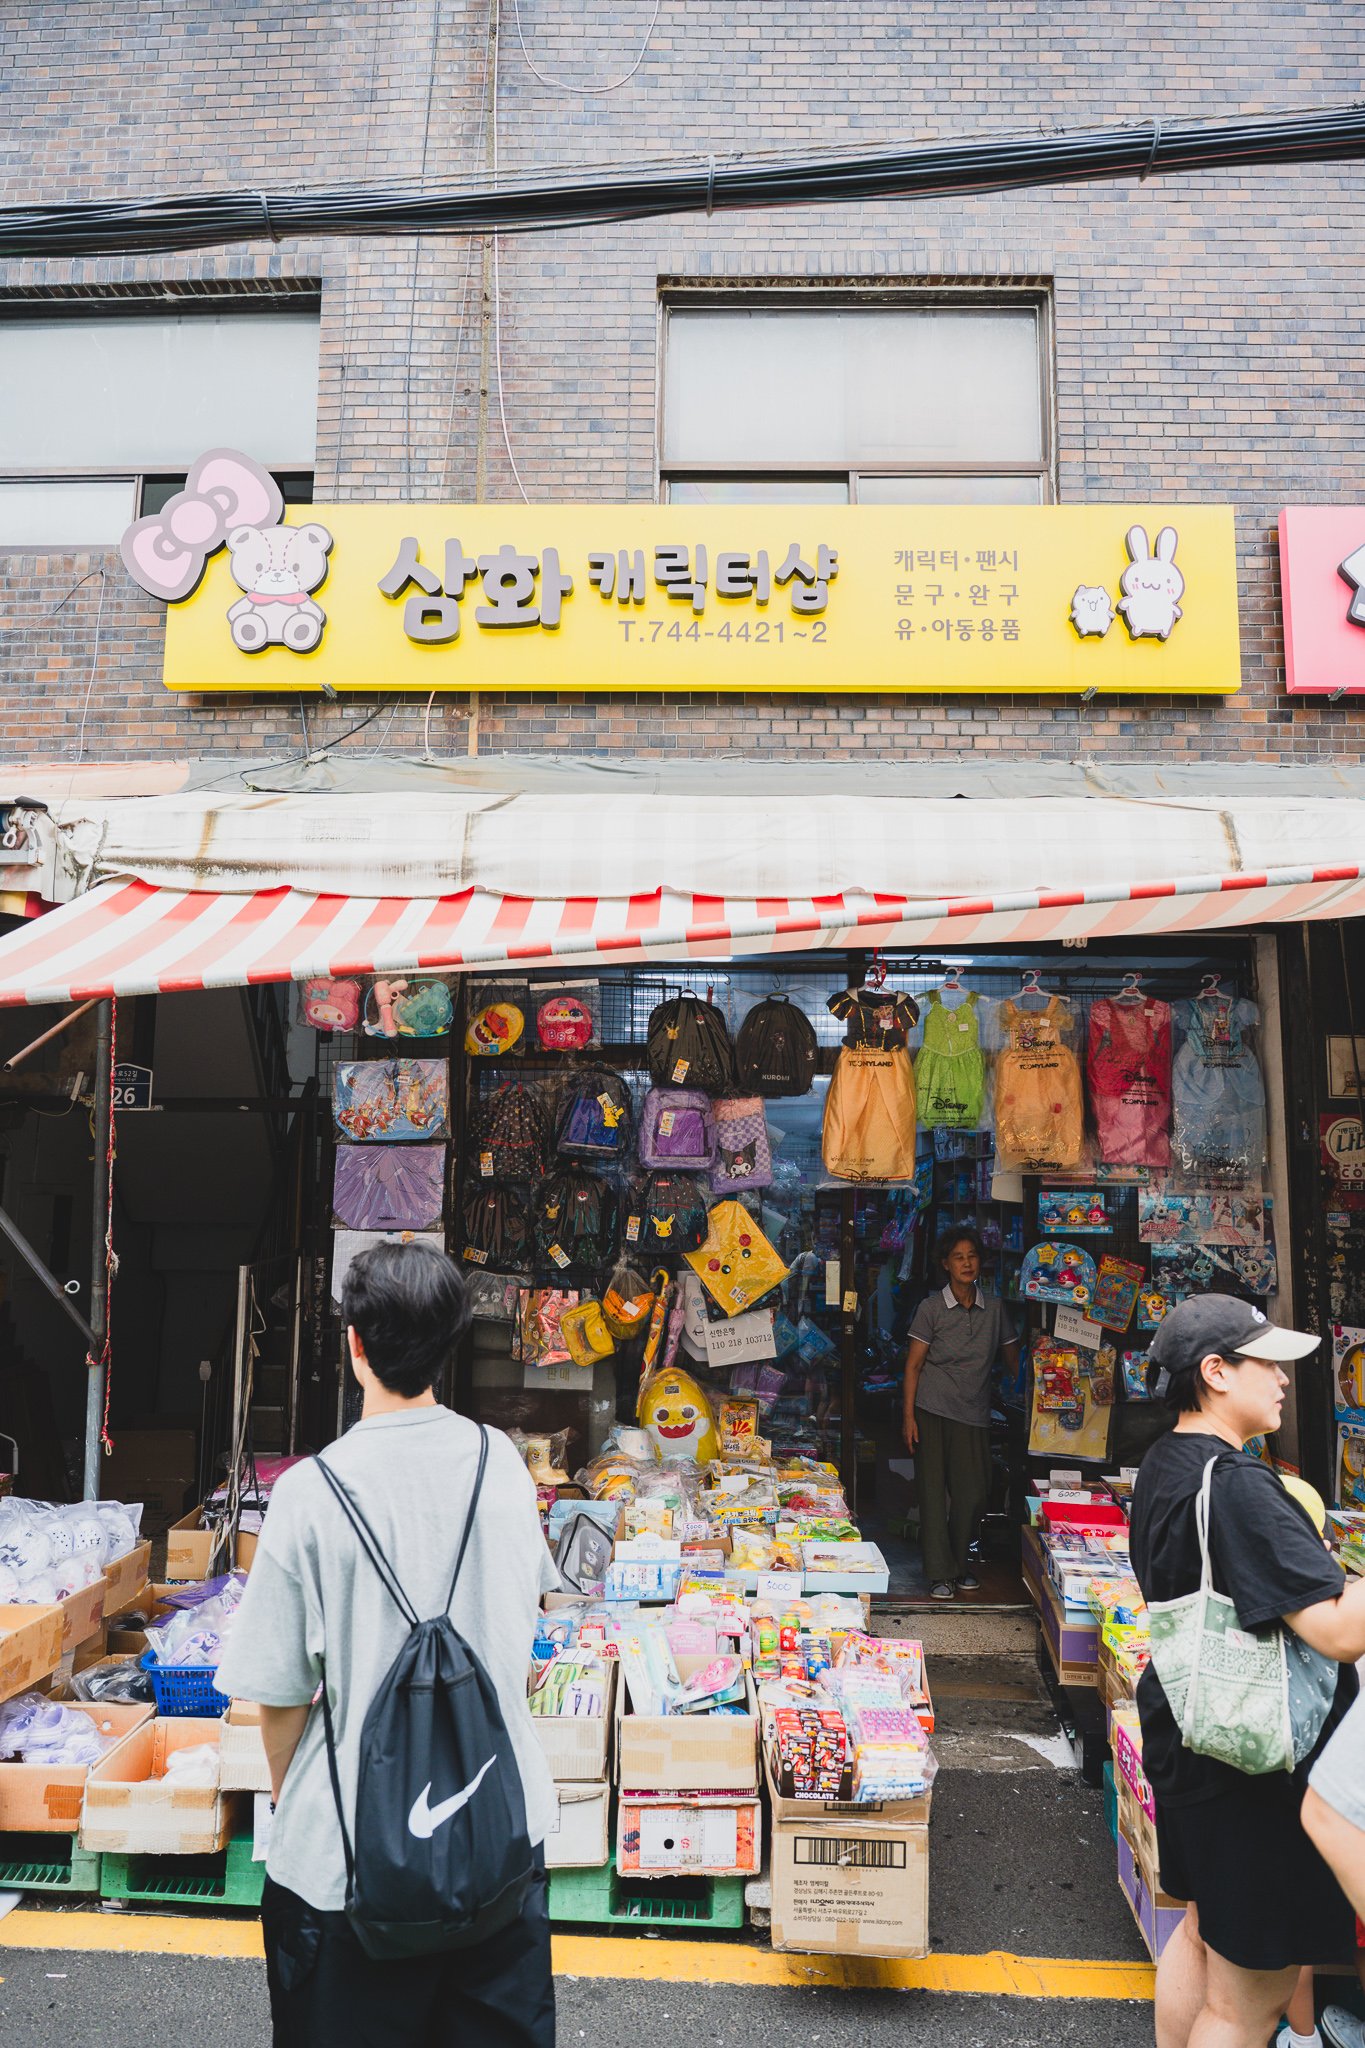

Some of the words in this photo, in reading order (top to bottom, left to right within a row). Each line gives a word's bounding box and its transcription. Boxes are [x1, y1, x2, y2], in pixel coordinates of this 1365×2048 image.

[377, 536, 575, 646] 삼화
[588, 543, 839, 616] 캐릭터샵
[619, 621, 828, 645] T.744-4421~2
[113, 1087, 136, 1105] 26
[709, 1327, 736, 1338] 신한은행
[712, 1341, 725, 1350] 110
[728, 1339, 742, 1348] 218
[745, 1333, 772, 1345] 103712
[794, 1791, 835, 1800] CHOCOLATE
